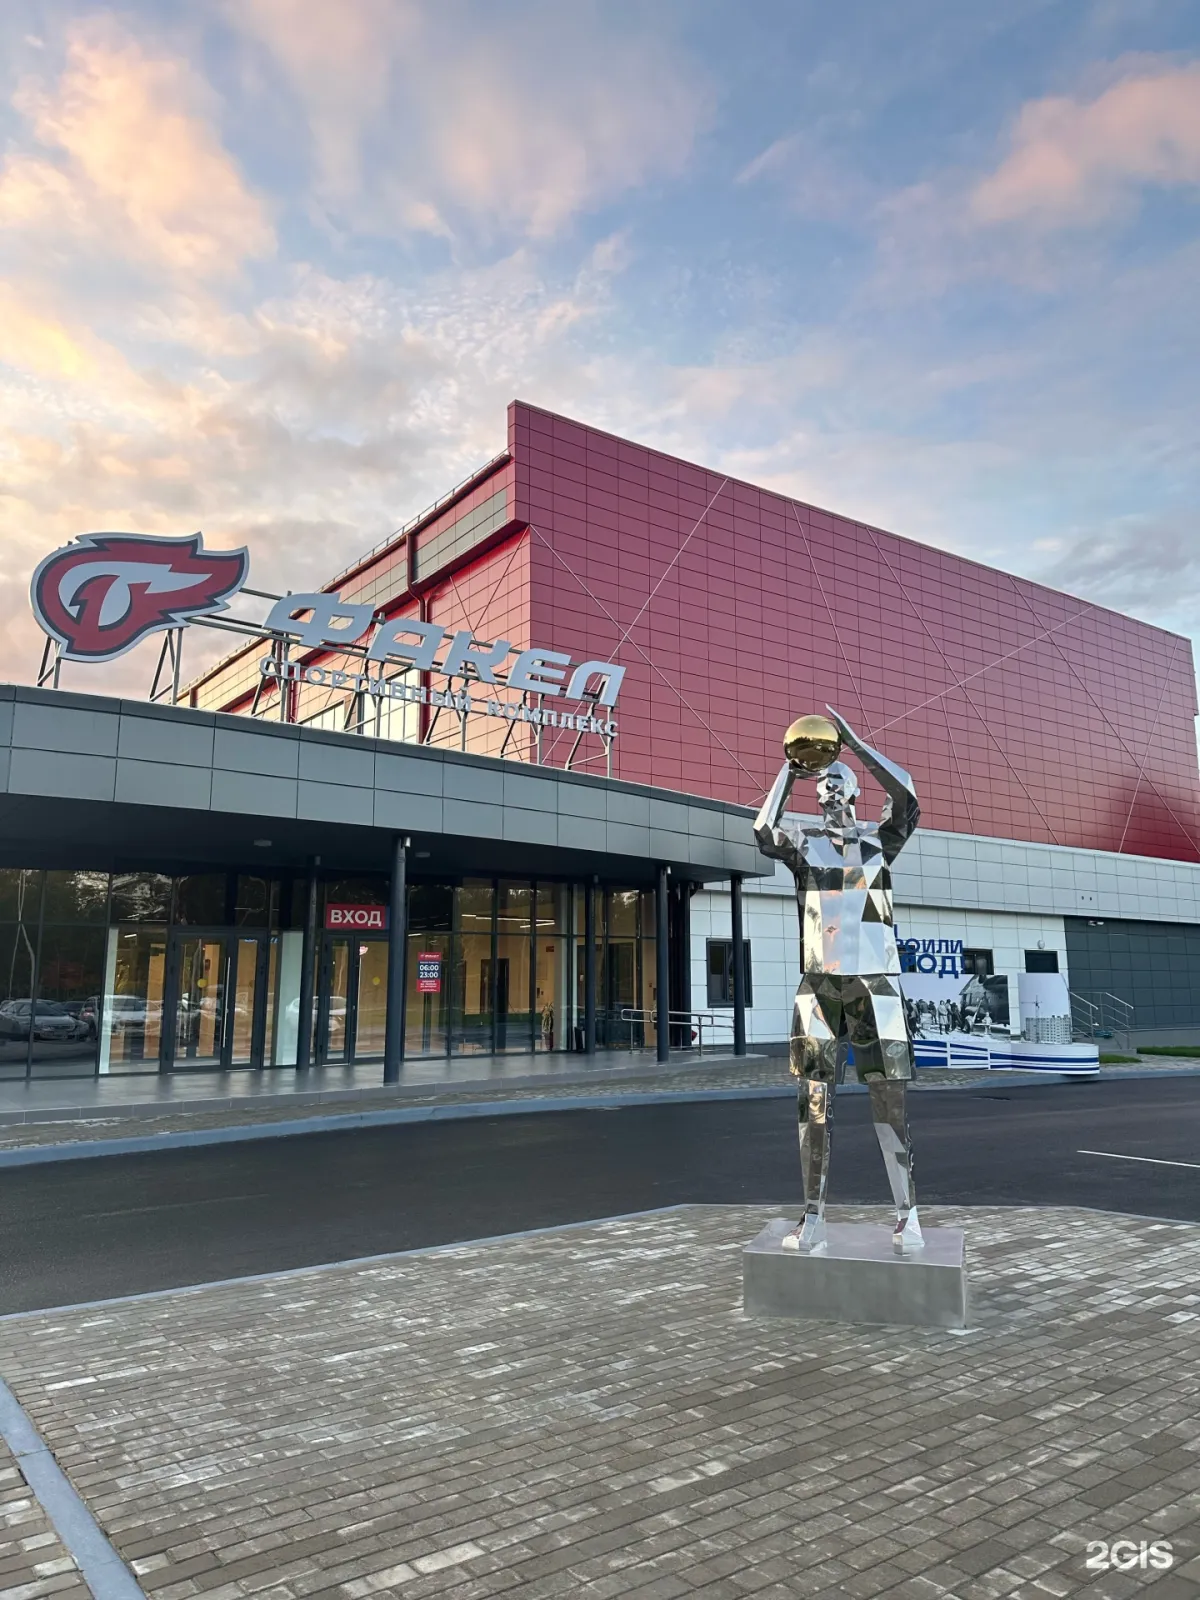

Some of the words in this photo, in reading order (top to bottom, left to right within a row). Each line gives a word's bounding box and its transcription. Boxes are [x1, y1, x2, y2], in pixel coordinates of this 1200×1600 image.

[262, 592, 626, 706] ФАКЕЛ
[259, 655, 472, 712] СПОРТИВНЫЙ
[487, 698, 618, 737] КОМПЛЕКС
[330, 909, 382, 927] ВХОД
